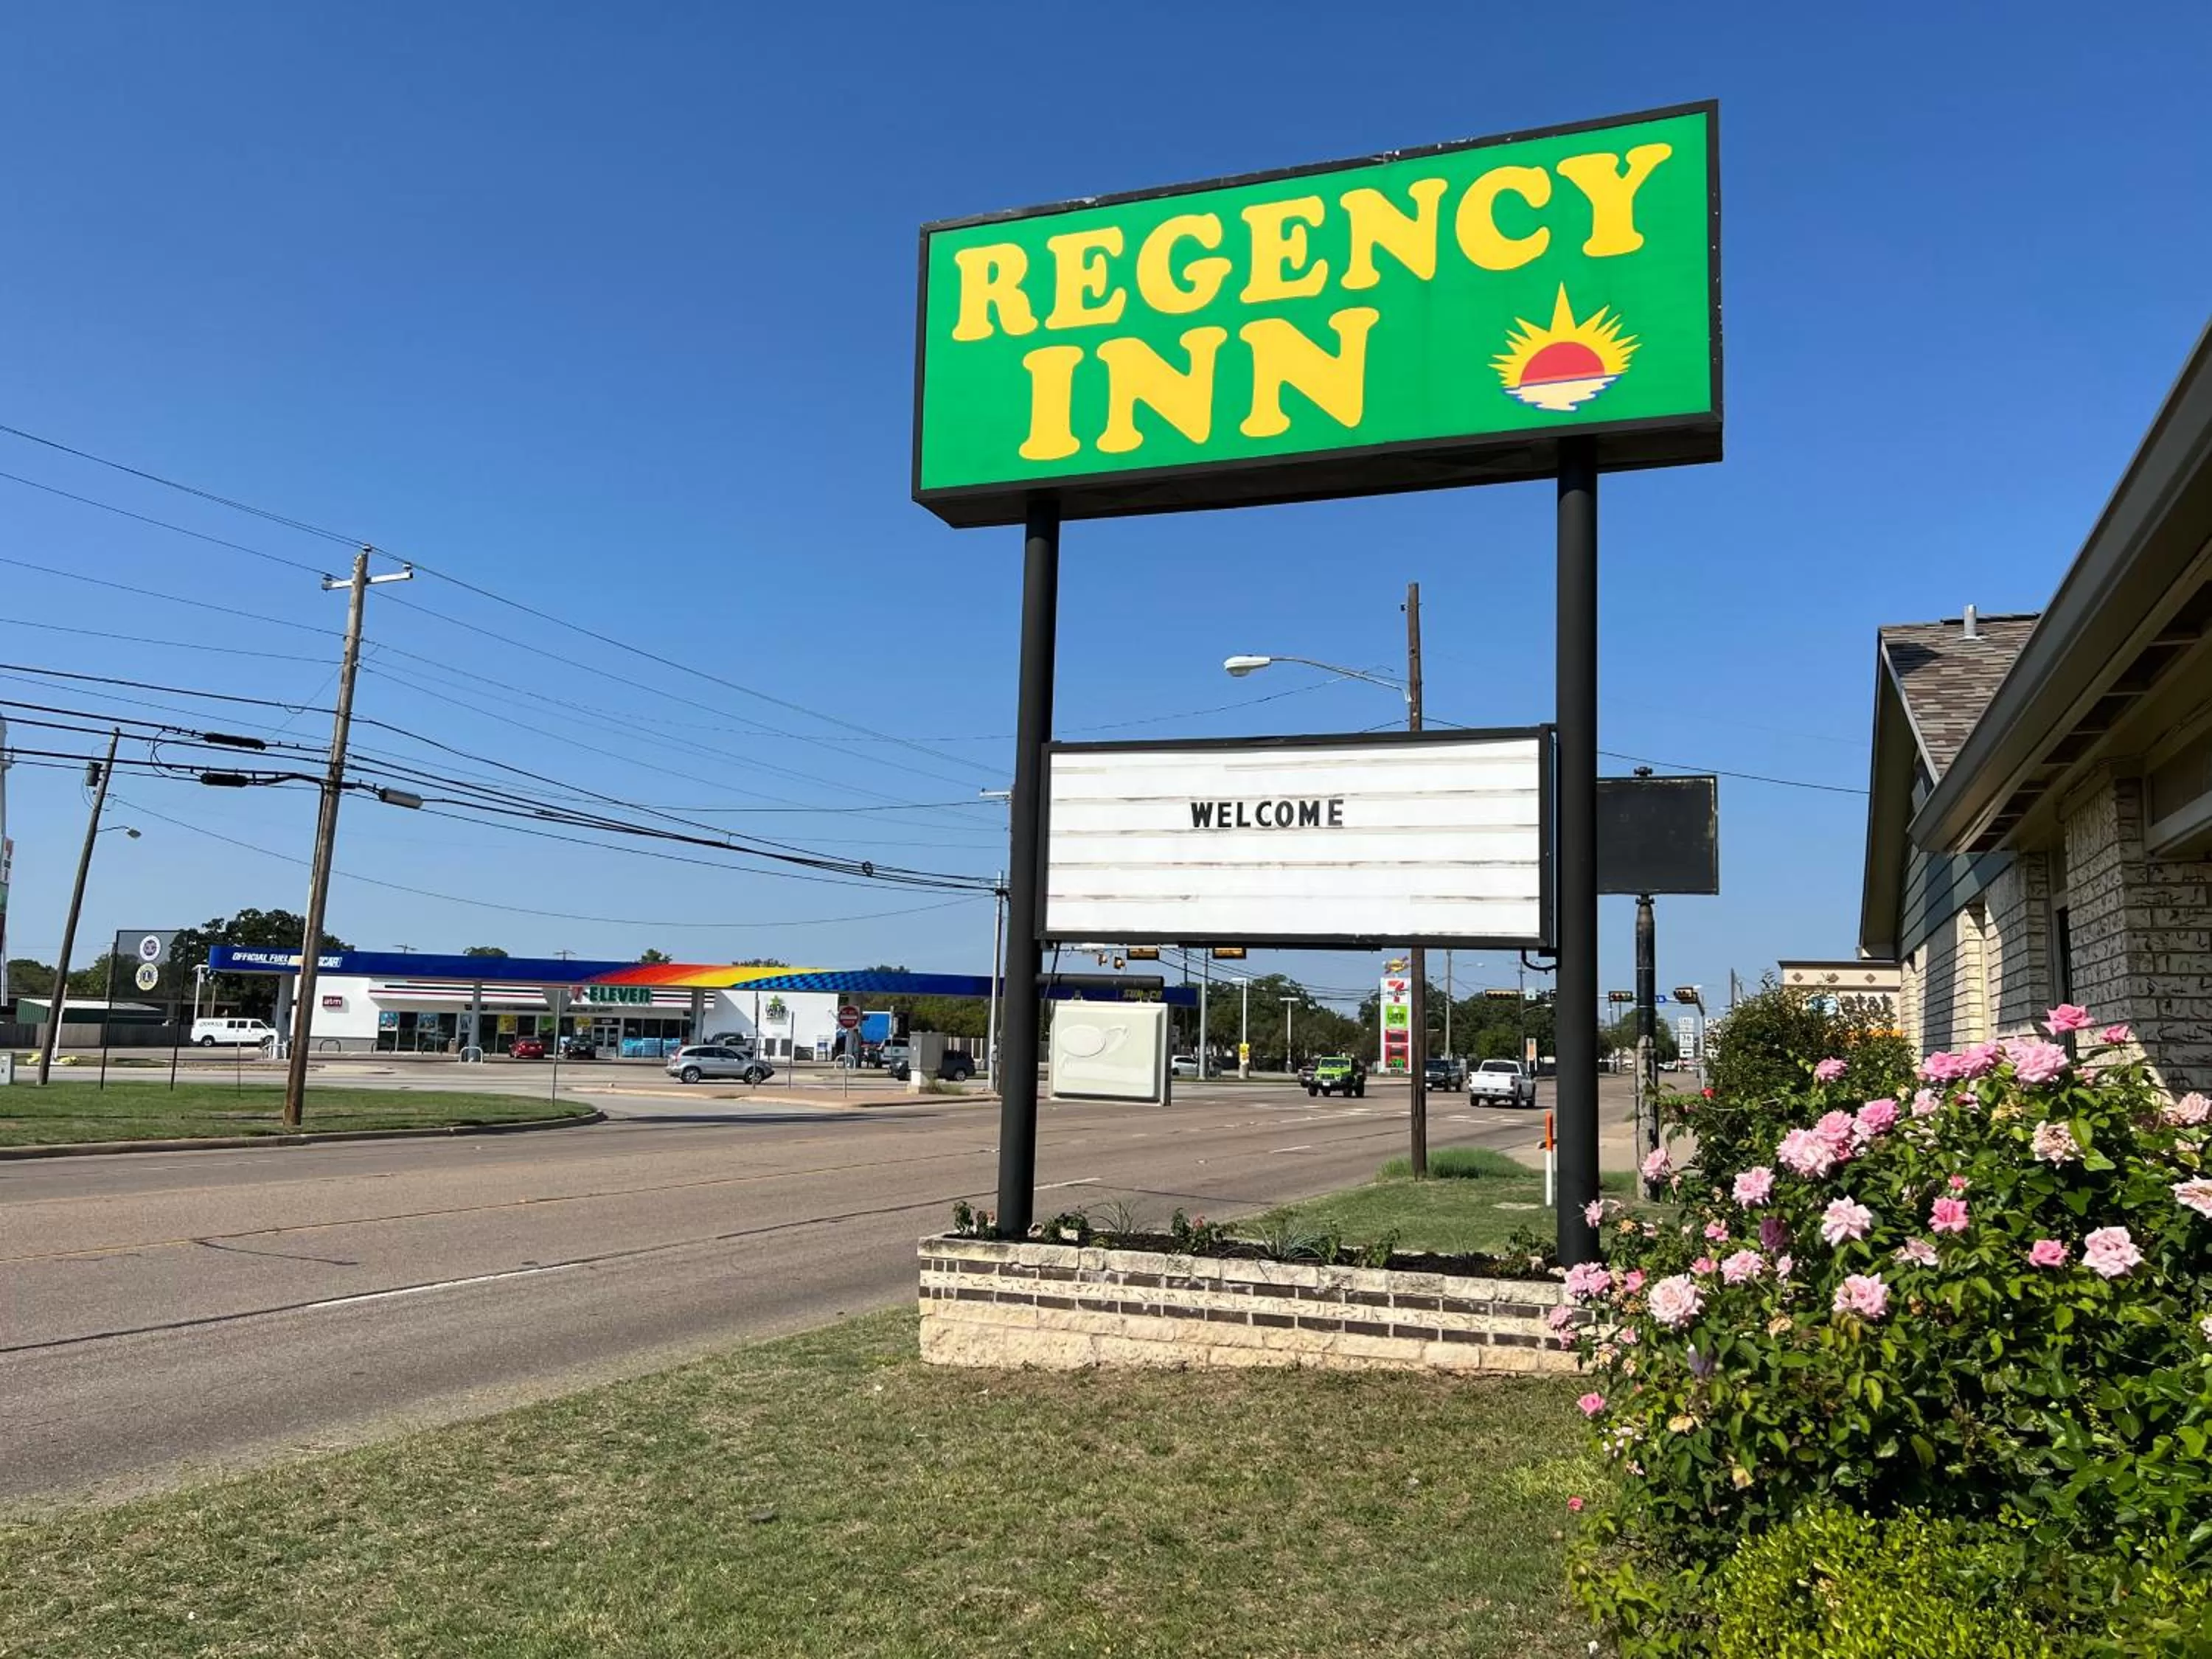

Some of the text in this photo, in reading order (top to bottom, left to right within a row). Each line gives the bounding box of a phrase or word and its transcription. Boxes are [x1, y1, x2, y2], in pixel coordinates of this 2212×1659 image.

[952, 142, 1672, 341] REGENCY
[1018, 307, 1380, 460] INN
[1191, 799, 1344, 828] WELCOME
[232, 953, 268, 961] OFFICIAL
[268, 954, 288, 962] FUEL
[324, 998, 341, 1006] atm
